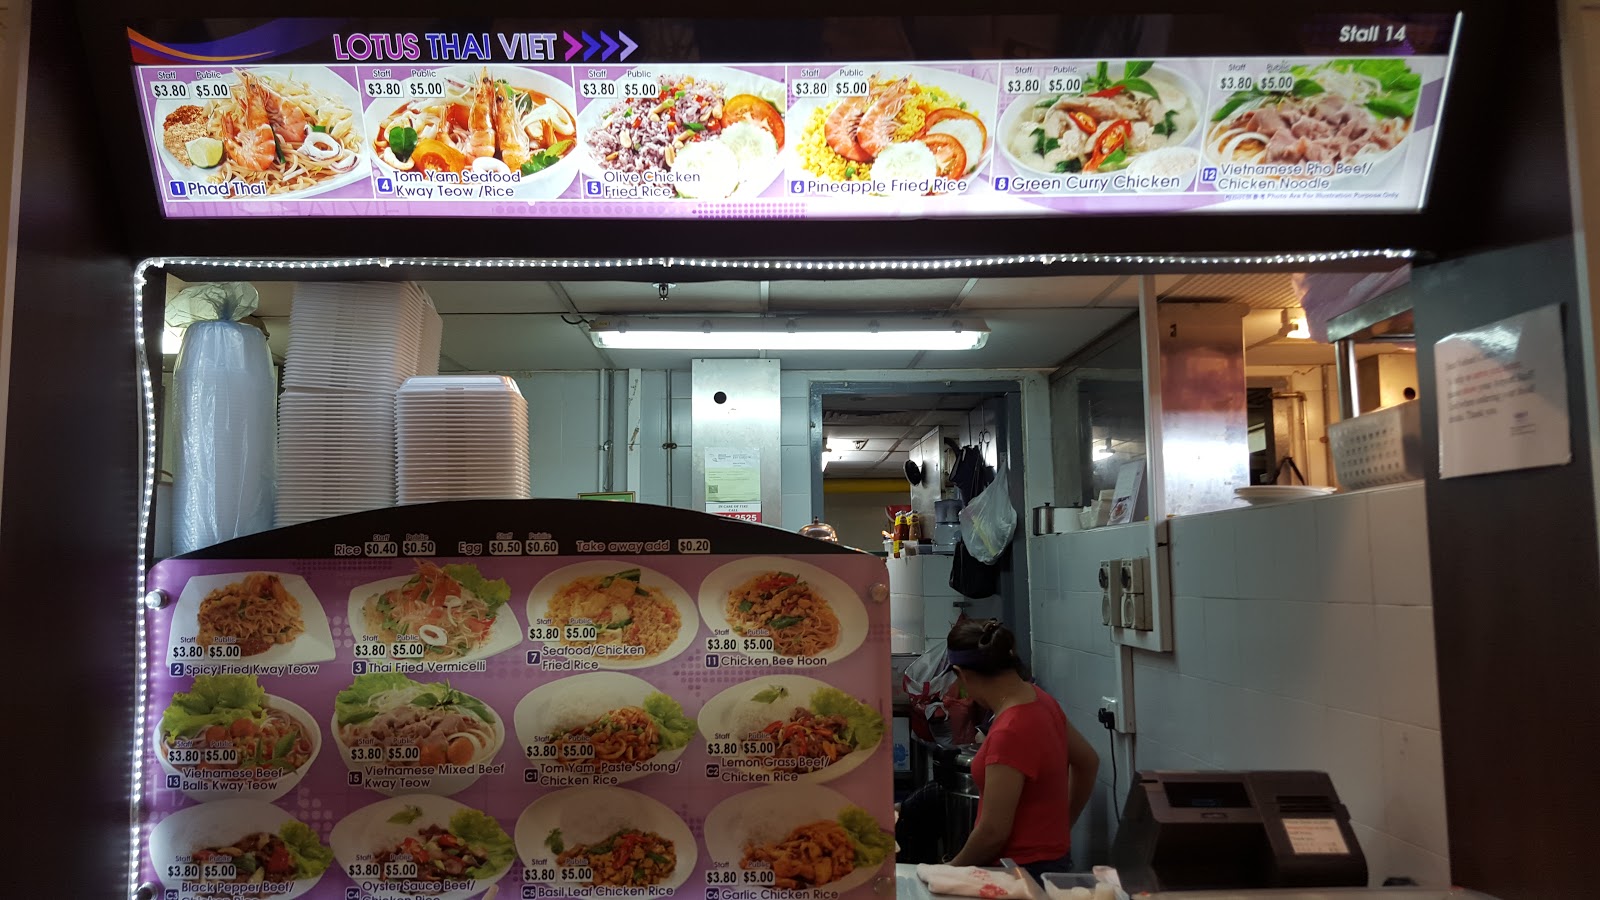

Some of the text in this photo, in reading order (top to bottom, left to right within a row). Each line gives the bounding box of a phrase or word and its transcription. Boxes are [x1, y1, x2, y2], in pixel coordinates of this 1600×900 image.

[1339, 25, 1406, 42] Stall 14
[333, 33, 557, 60] LOTUS THAI VIET
[158, 70, 221, 80] Staff Public
[373, 69, 436, 78] Staff Public
[588, 70, 651, 78] Staff Public
[801, 68, 863, 77] Staff Public
[1015, 65, 1077, 74] Staff Public
[796, 81, 867, 95] $3.80 $5.00
[1007, 79, 1081, 92] $3.80 $5.00
[1220, 76, 1293, 90] $3.80 $5.00
[154, 83, 228, 98] $3.80 $5.00
[368, 82, 442, 97] $3.80 $5.00
[583, 83, 656, 96] $3.80 $5.00
[1221, 162, 1373, 176] Vietnamese Pho Beef/
[394, 171, 520, 183] Tom Yam Seafood
[604, 171, 700, 183] Olive Chicken
[188, 181, 266, 196] Phad Thai
[808, 179, 967, 195] Pineapple Fried Rice
[1011, 175, 1180, 192] Green Curry Chicken
[1218, 177, 1329, 190] Chicken Noodle
[396, 186, 433, 198] Kway
[438, 186, 475, 197] Teow
[604, 186, 671, 197] Fried Rice
[335, 541, 434, 556] Rice $0.40 $0.50
[459, 541, 557, 556] Egg $0.50 $0.60
[577, 539, 708, 554] Take away add $0.20
[529, 627, 596, 639] $3.80 $5.00
[355, 644, 422, 657] $3.80 $5.00
[708, 639, 773, 650] $3.80 $5.00
[173, 645, 239, 657] $3.80 $5.00
[542, 645, 644, 657] Seafood/Chicken
[368, 661, 486, 672] Thai Fried Vermicelli
[542, 660, 598, 671] Fried Rice
[721, 656, 827, 667] Chicken Bee Hoon
[185, 663, 319, 677] Spicy Fried Kway Teow
[351, 748, 418, 760] $3.80 $5.00
[527, 745, 593, 757] $3.80 $5.00
[708, 742, 773, 754] $3.80 $5.00
[169, 750, 236, 761] $3.80 $5.00
[722, 756, 830, 768] Lemon Grass Beef/
[183, 768, 283, 778] Vietnamese Beef
[365, 763, 504, 775] Vietnamese Mixed Beef
[540, 762, 681, 775] Tom Yam Paste Sotong/
[540, 774, 617, 786] Chicken Rice
[722, 771, 798, 782] Chicken Rice
[183, 780, 277, 792] Balls Kway Teow
[365, 777, 430, 789] Kway Teow
[168, 865, 235, 877] $3.80 $5.00
[349, 864, 416, 876] $3.80 $5.00
[524, 868, 591, 881] $3.80 $5.00
[707, 871, 773, 884] $3.80 $5.00
[182, 881, 295, 894] Black Pepper Beef/
[362, 880, 475, 893] Oyster Sauce Beef/
[539, 886, 674, 897] Basil Leaf Chicken Rice
[721, 889, 838, 900] Garlic Chicken Rice
